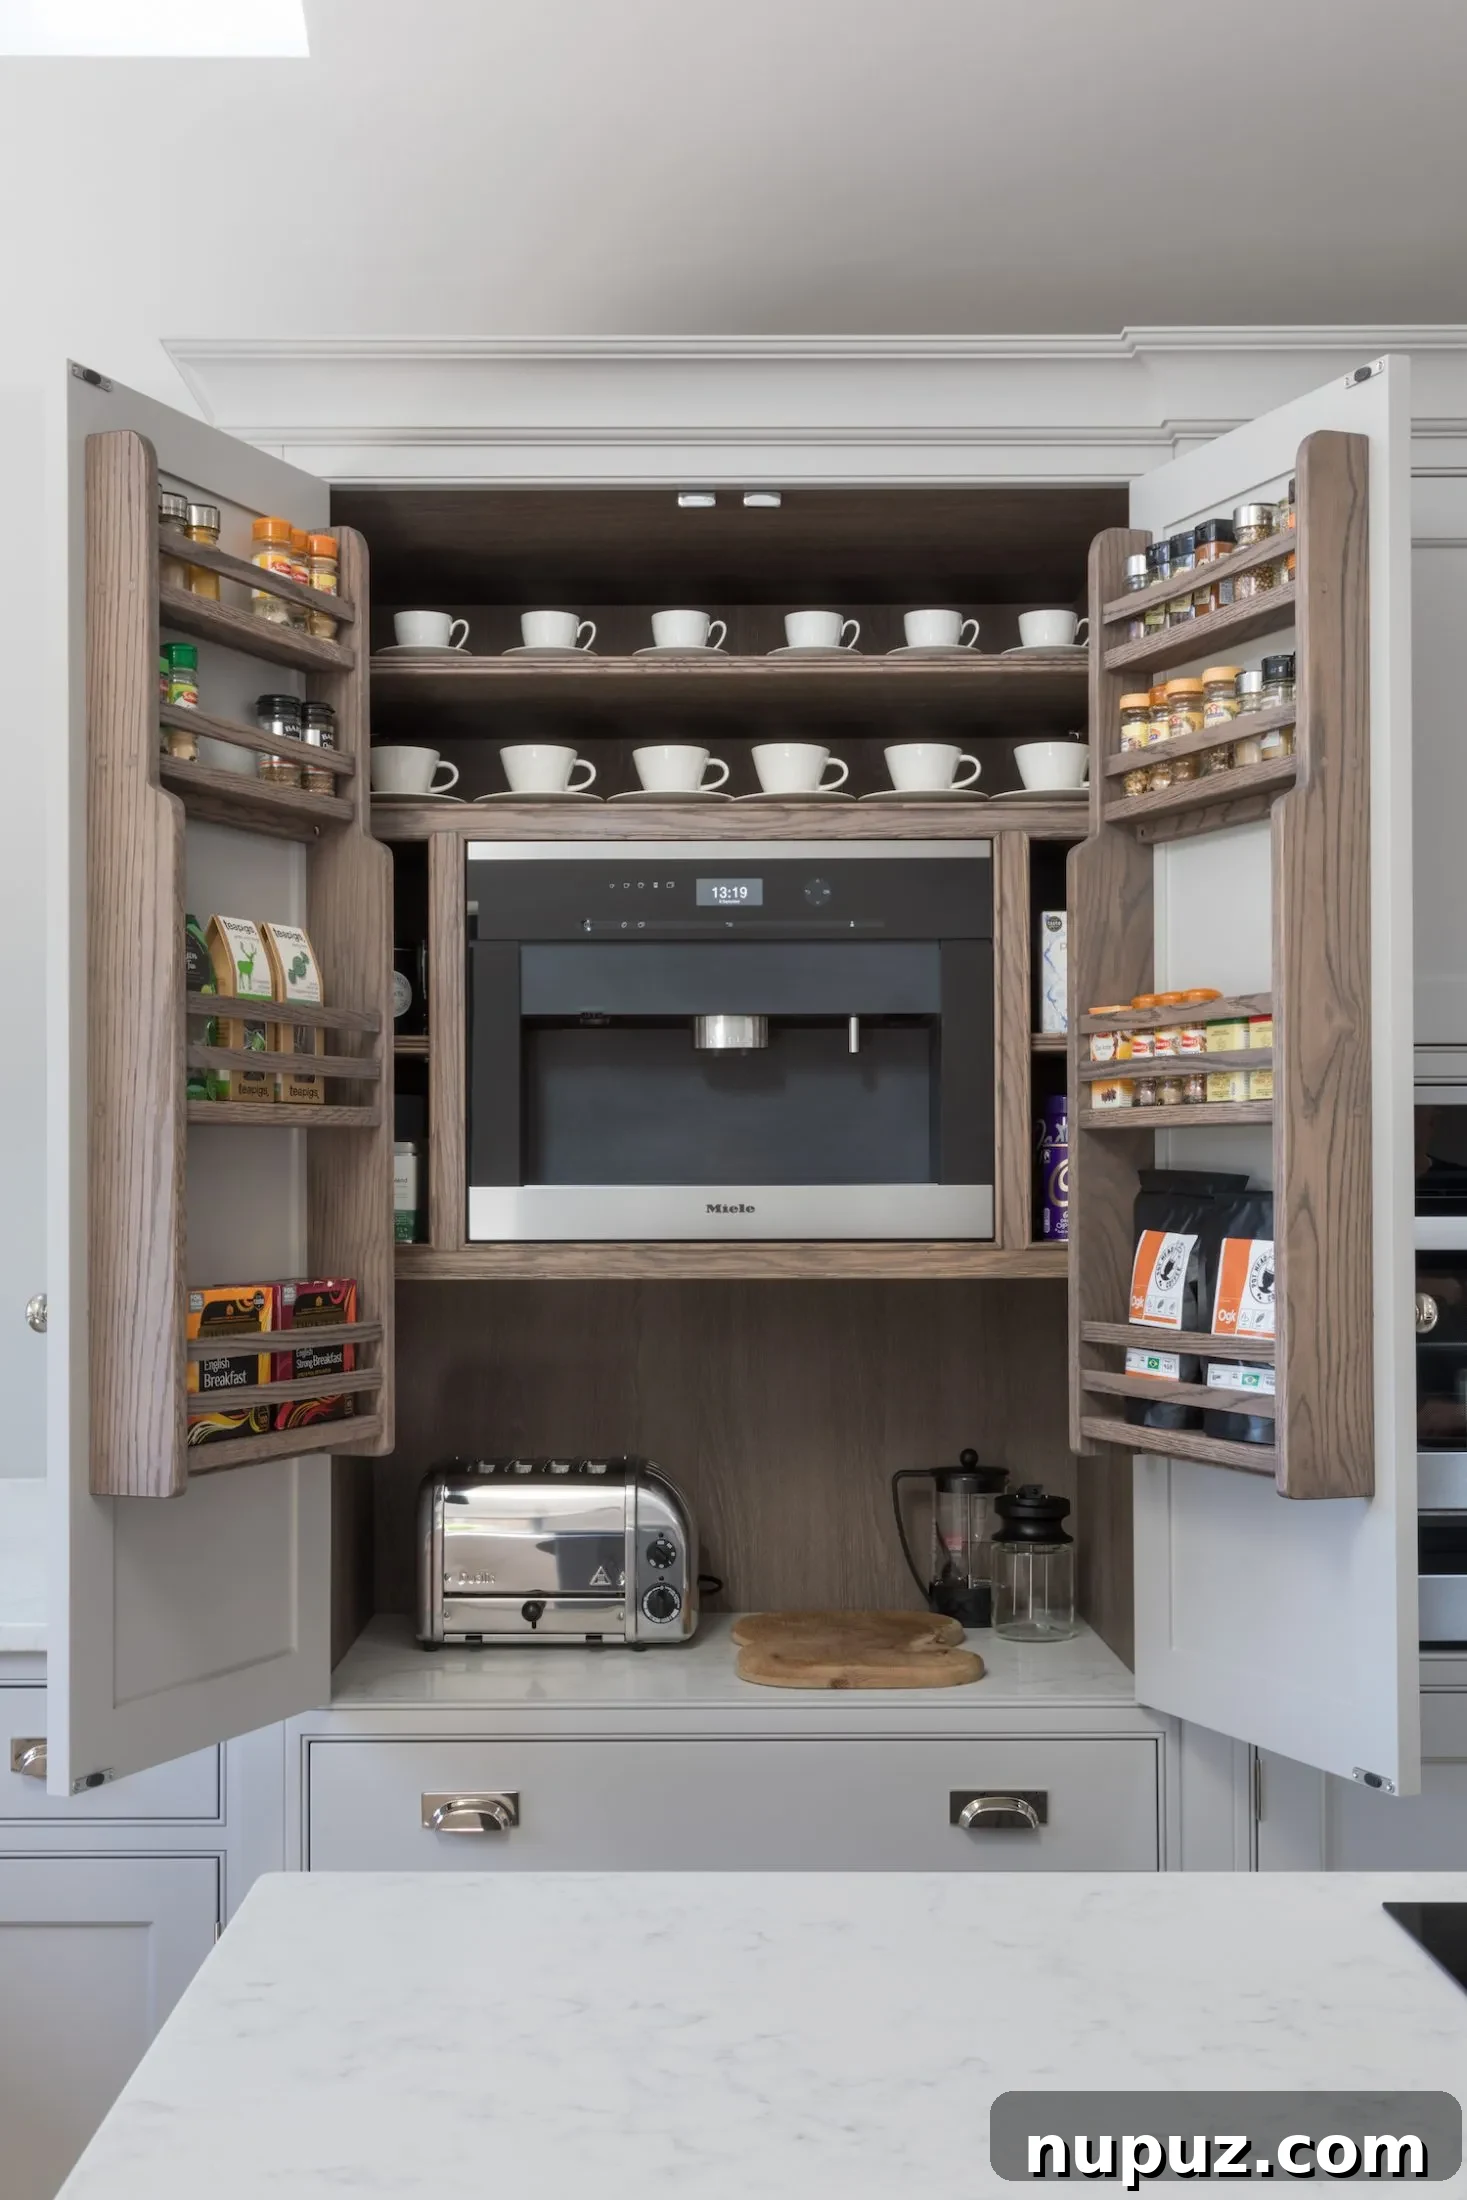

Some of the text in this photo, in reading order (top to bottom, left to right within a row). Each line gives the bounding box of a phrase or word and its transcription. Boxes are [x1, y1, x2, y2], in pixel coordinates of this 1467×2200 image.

[711, 886, 748, 899] 13:19
[705, 1203, 756, 1214] Miele
[204, 1357, 230, 1373] English
[296, 1351, 343, 1370] Strong Breakfast
[203, 1370, 247, 1389] Breakfast
